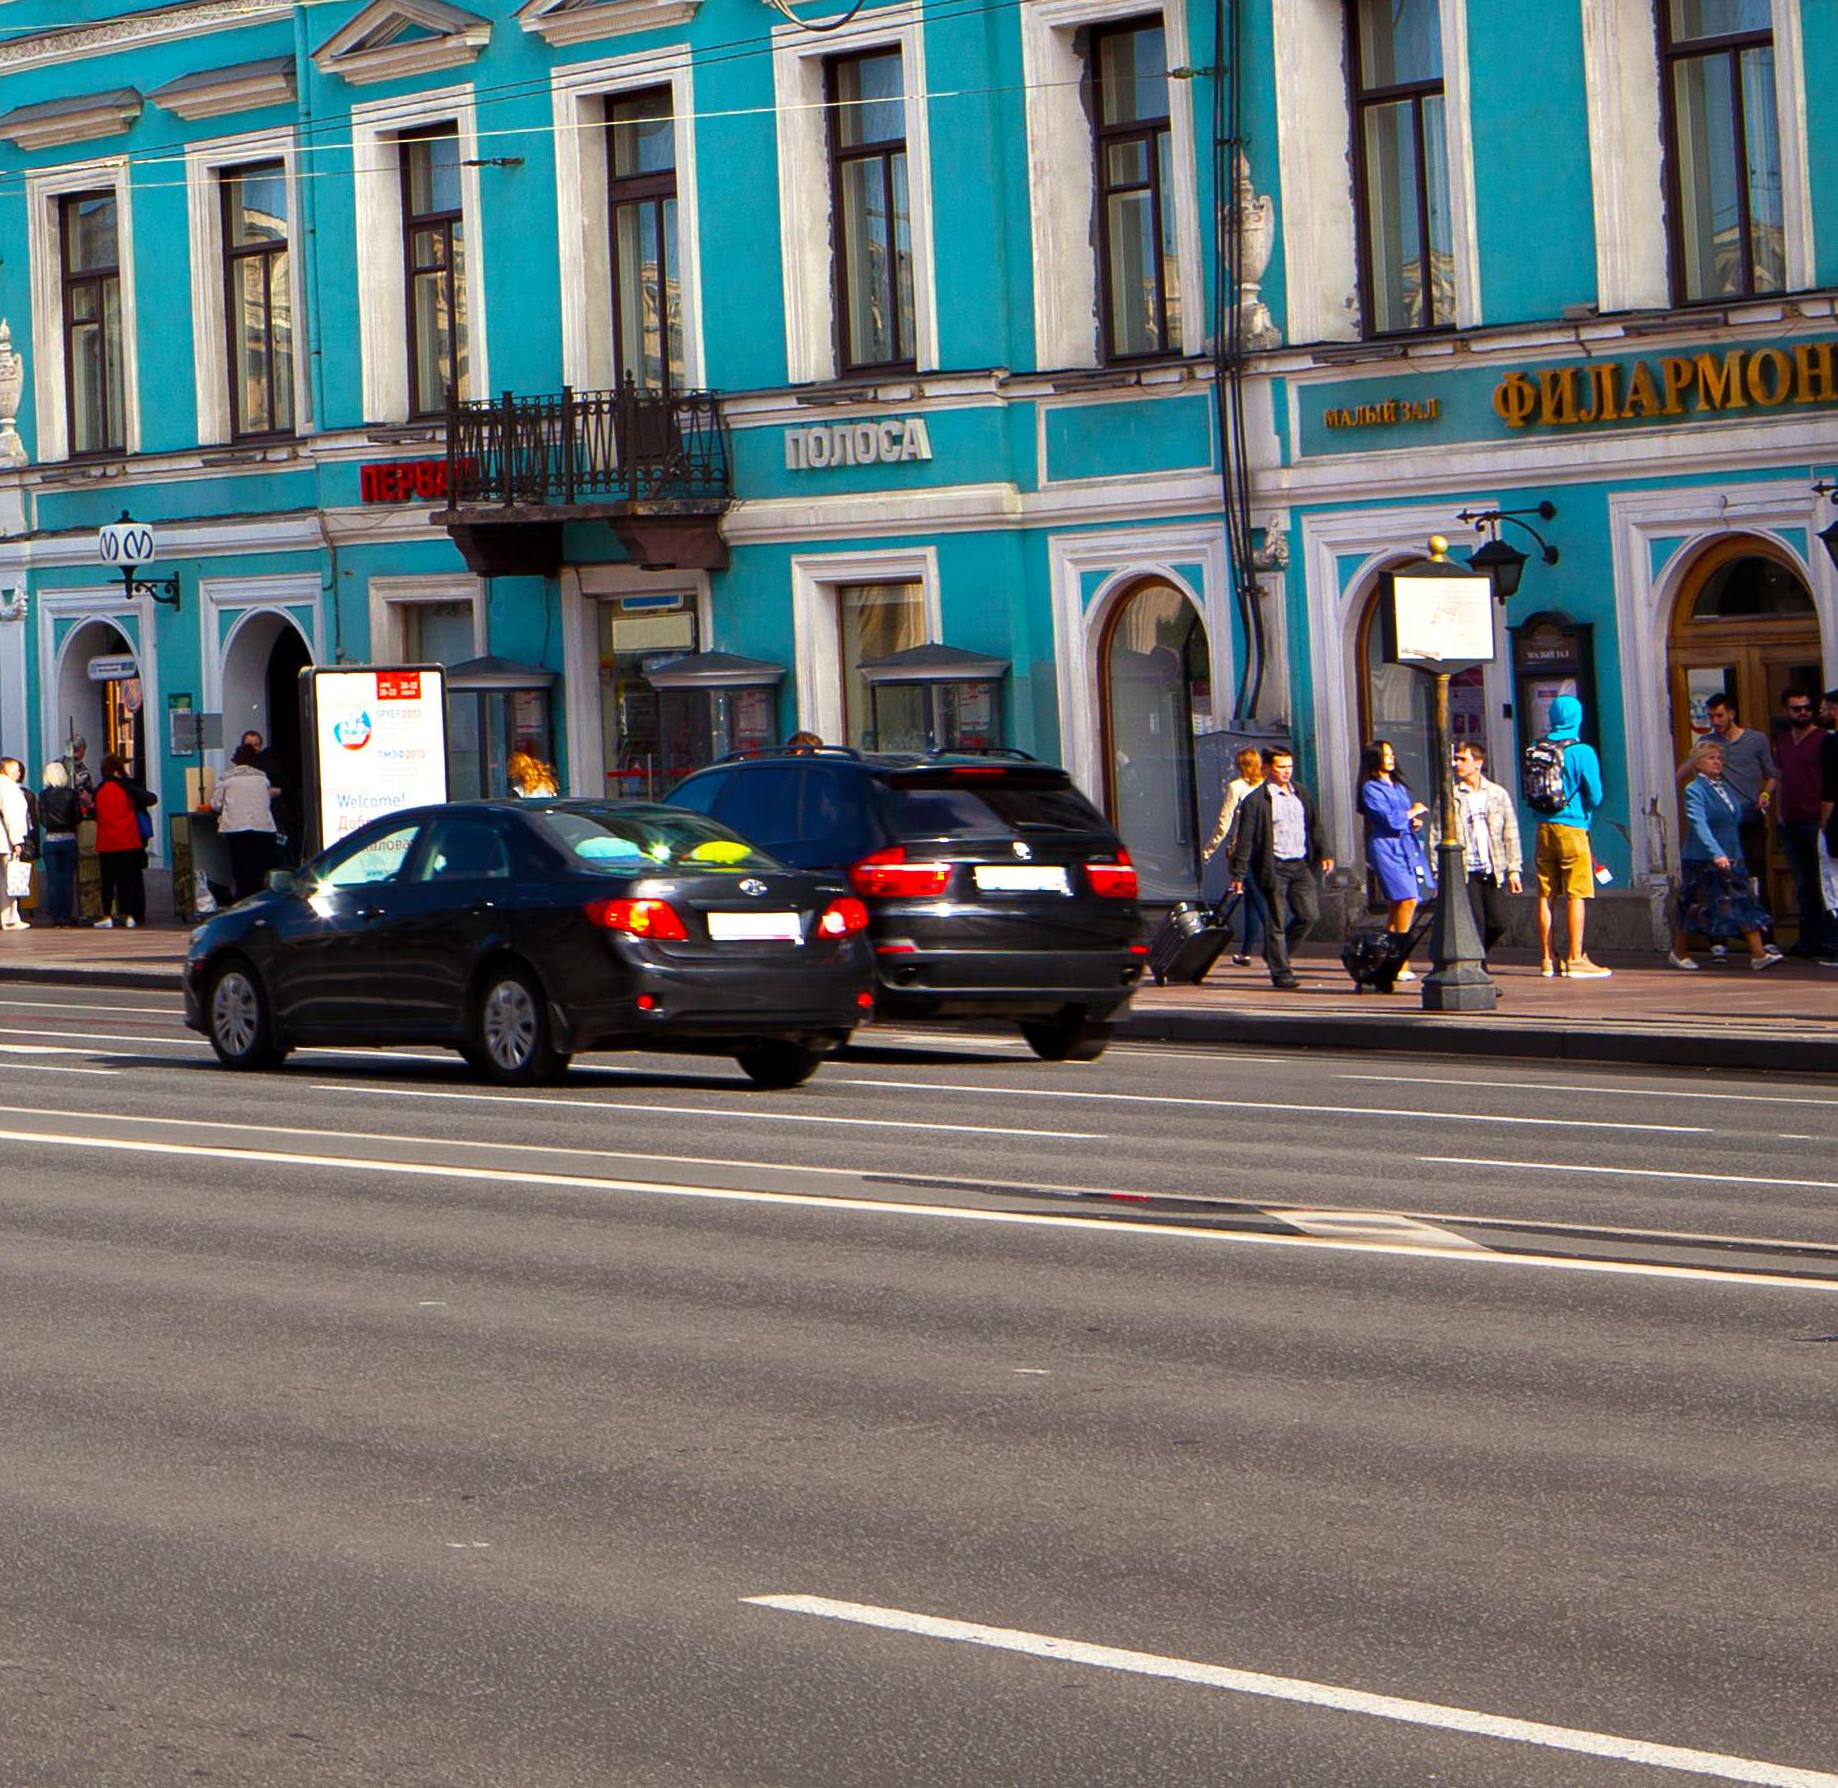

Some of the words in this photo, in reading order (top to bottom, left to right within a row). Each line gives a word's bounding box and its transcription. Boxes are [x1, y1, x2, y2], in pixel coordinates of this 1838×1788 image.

[1492, 342, 1838, 428] ФИЛАРМОН
[1324, 399, 1396, 428] МАЛЫЙ
[1401, 397, 1440, 422] ЗАЛ
[784, 417, 933, 470] ПОЛОСА
[337, 793, 406, 809] Welcome!
